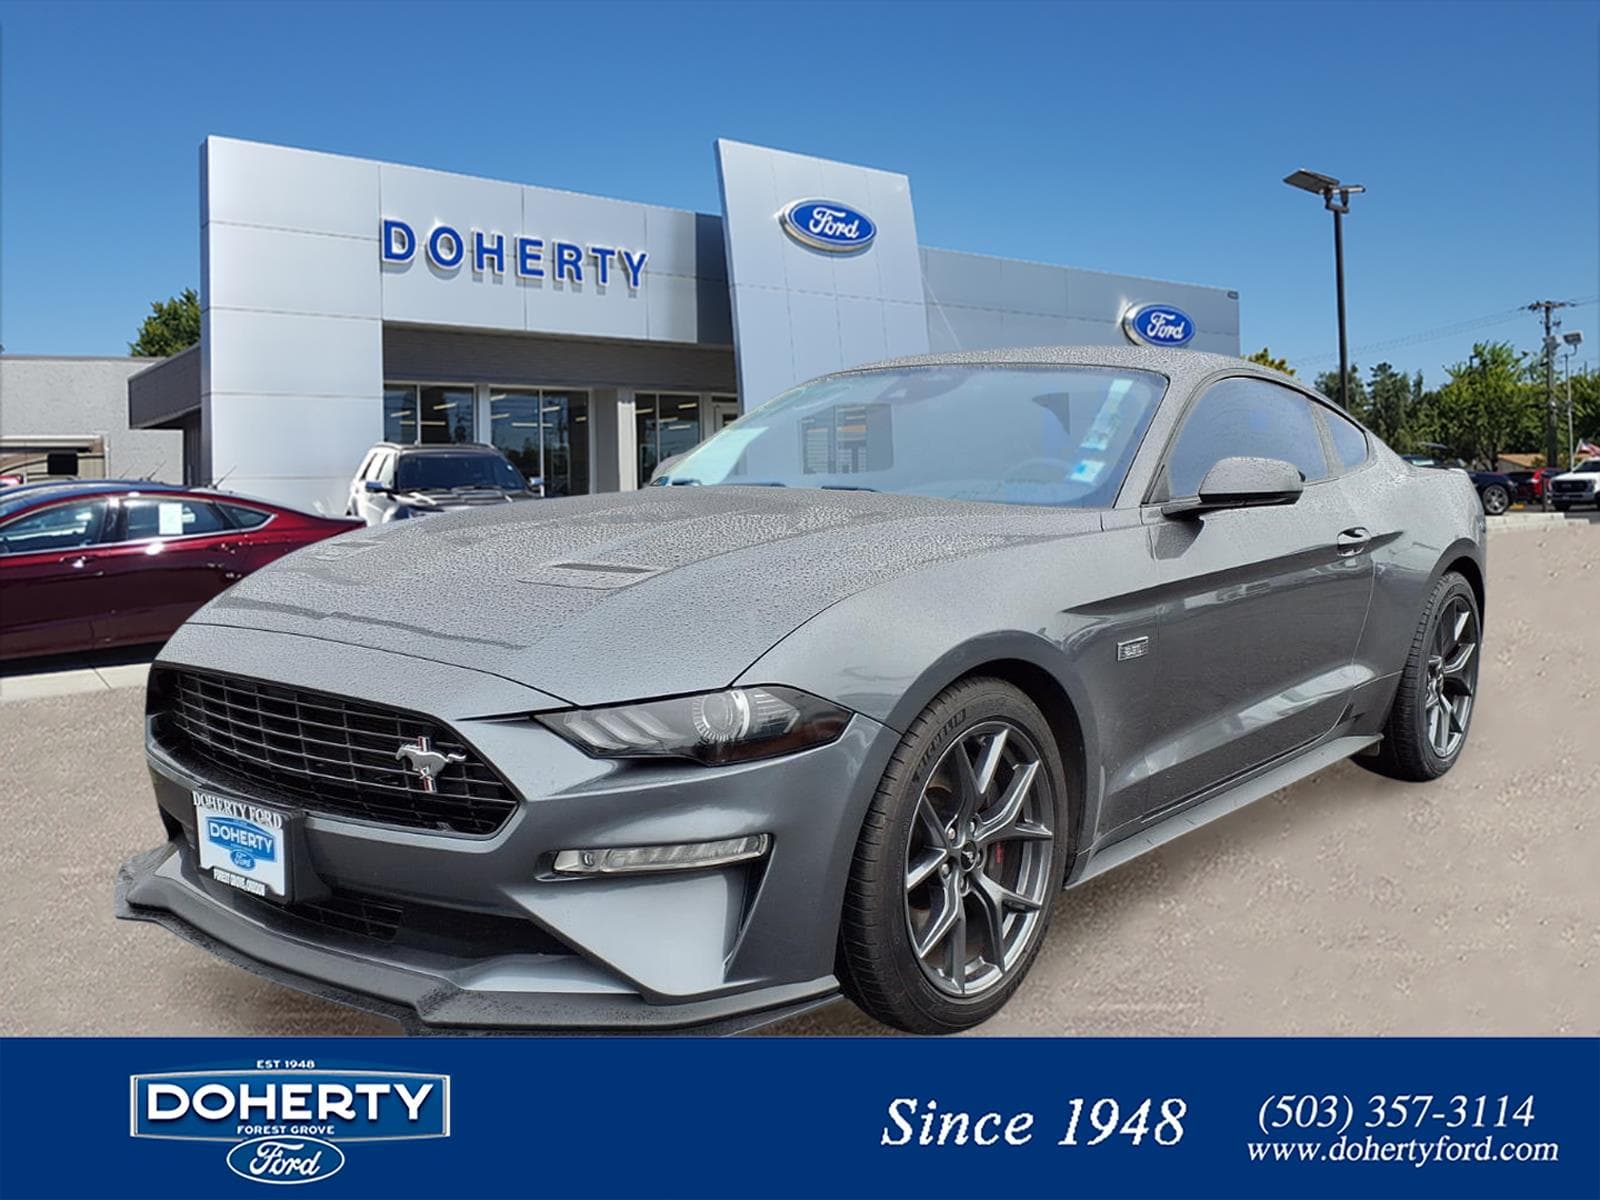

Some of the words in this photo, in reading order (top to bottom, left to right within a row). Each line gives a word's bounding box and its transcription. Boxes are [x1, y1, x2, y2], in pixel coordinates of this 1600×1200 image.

[808, 207, 860, 239] Ford
[381, 218, 648, 289] DOHERTY
[1146, 311, 1186, 340] Ford
[192, 790, 247, 818] DOHERTY
[249, 805, 283, 830] FORD
[209, 822, 273, 854] DOHERTY
